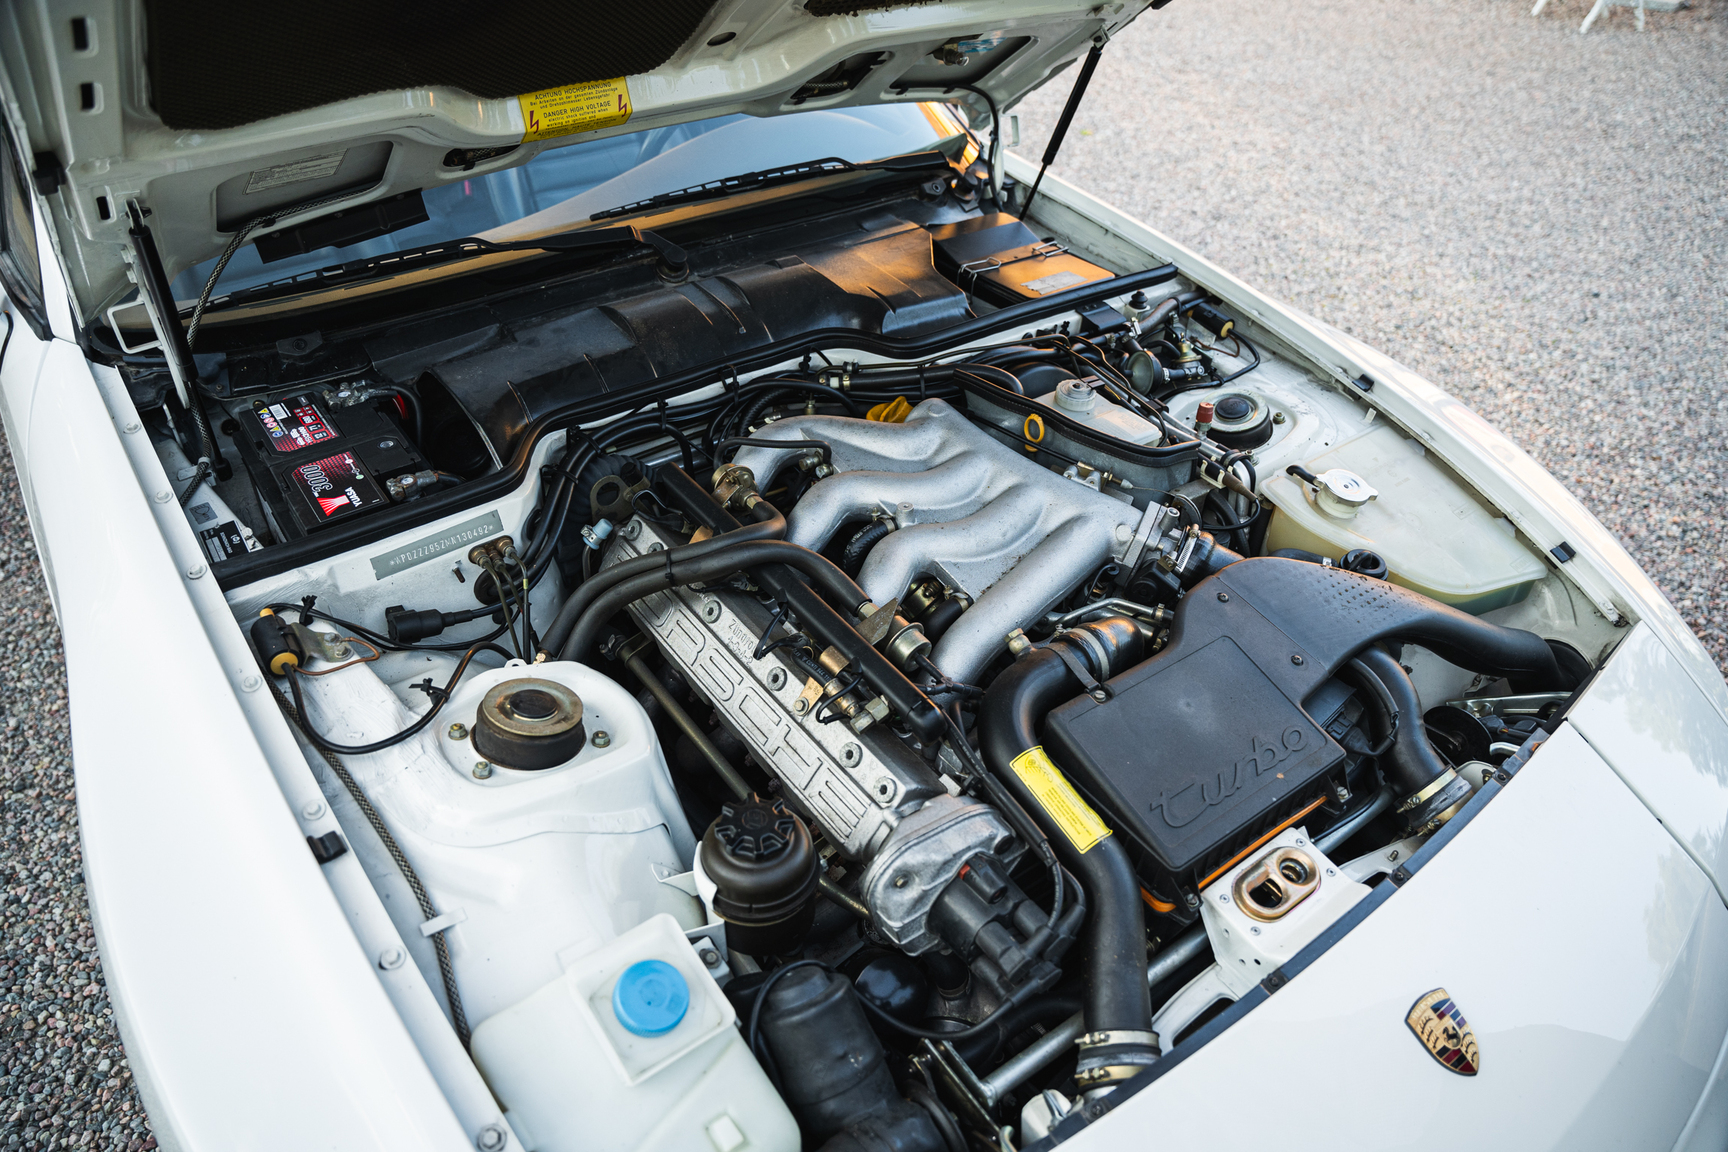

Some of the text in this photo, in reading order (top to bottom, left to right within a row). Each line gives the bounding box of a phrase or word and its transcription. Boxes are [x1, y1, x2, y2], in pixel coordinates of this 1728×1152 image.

[534, 81, 611, 100] ACHTUNG HOCHSPANNUNG
[542, 109, 568, 118] DANGER
[585, 101, 610, 110] VOLTAGE
[300, 464, 333, 493] 3000
[344, 486, 363, 508] YUASA
[1150, 725, 1309, 828] turbo
